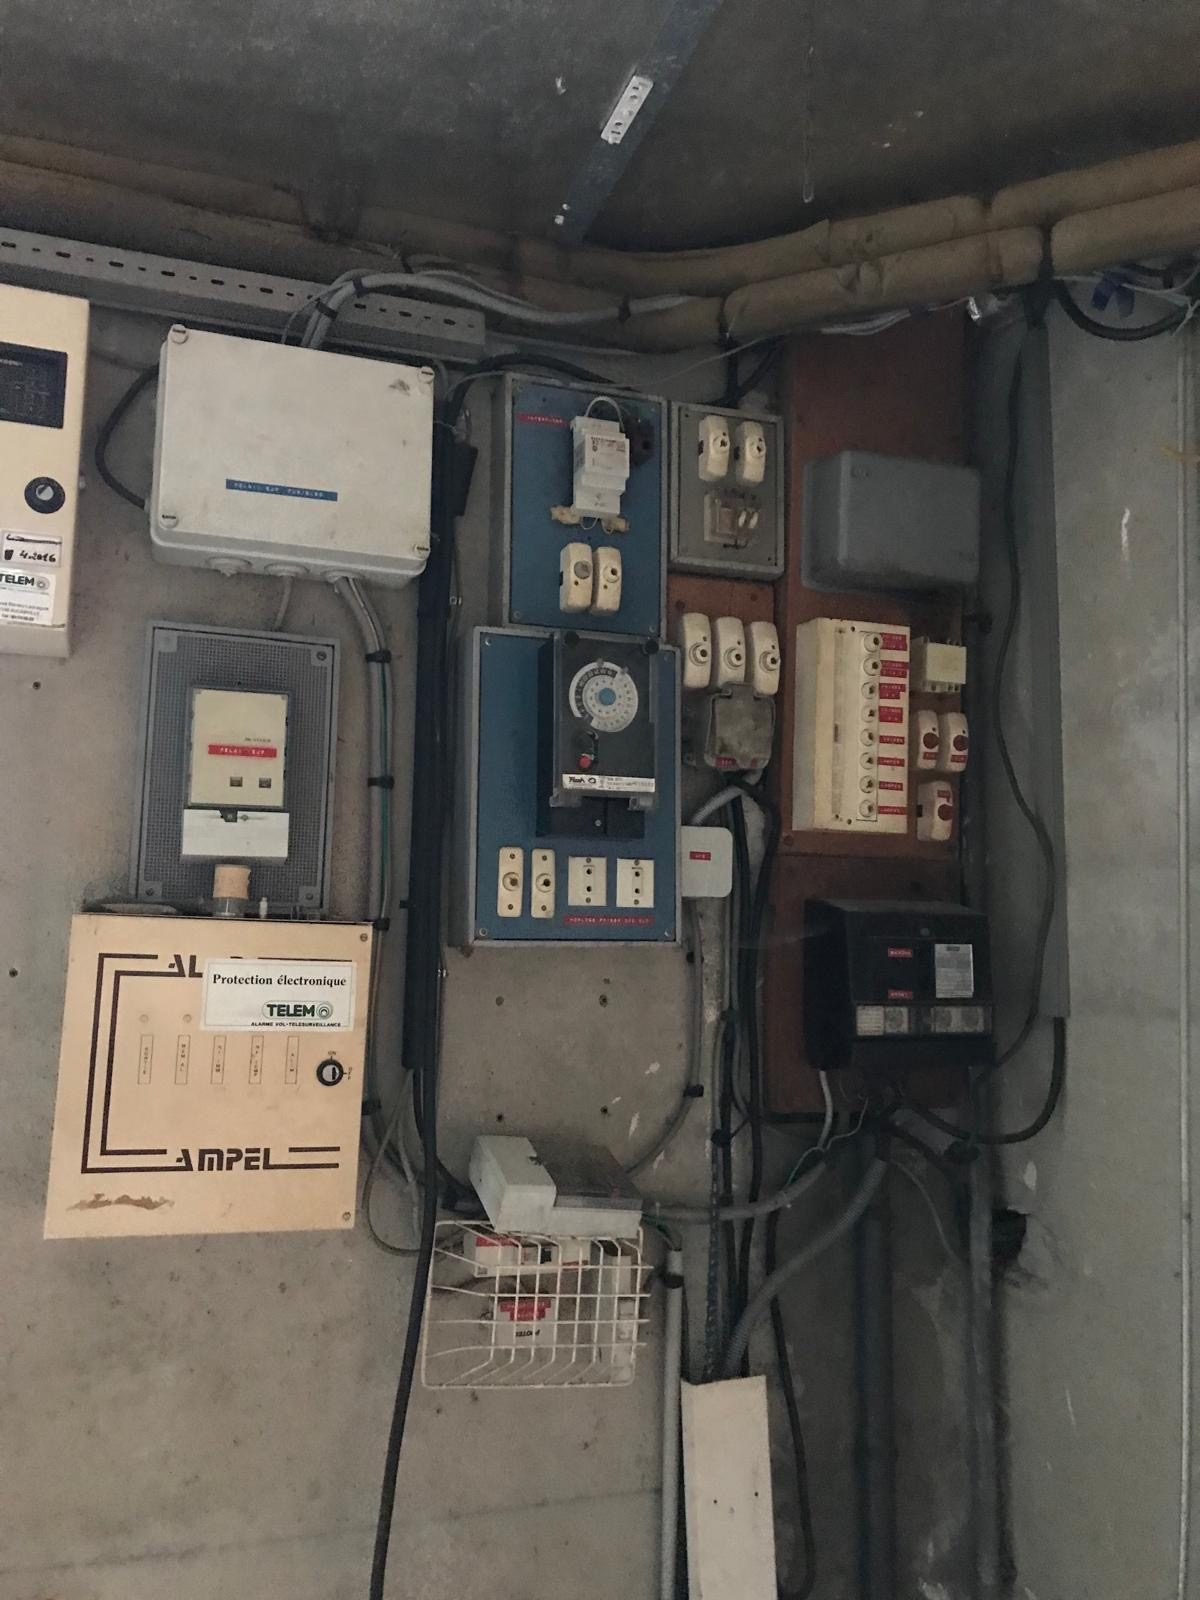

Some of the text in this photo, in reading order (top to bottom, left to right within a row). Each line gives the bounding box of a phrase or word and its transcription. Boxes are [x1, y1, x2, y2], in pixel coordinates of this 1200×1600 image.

[212, 973, 347, 988] Protection électronique
[266, 1003, 315, 1017] TELEM
[176, 1147, 270, 1171] AMPEL
